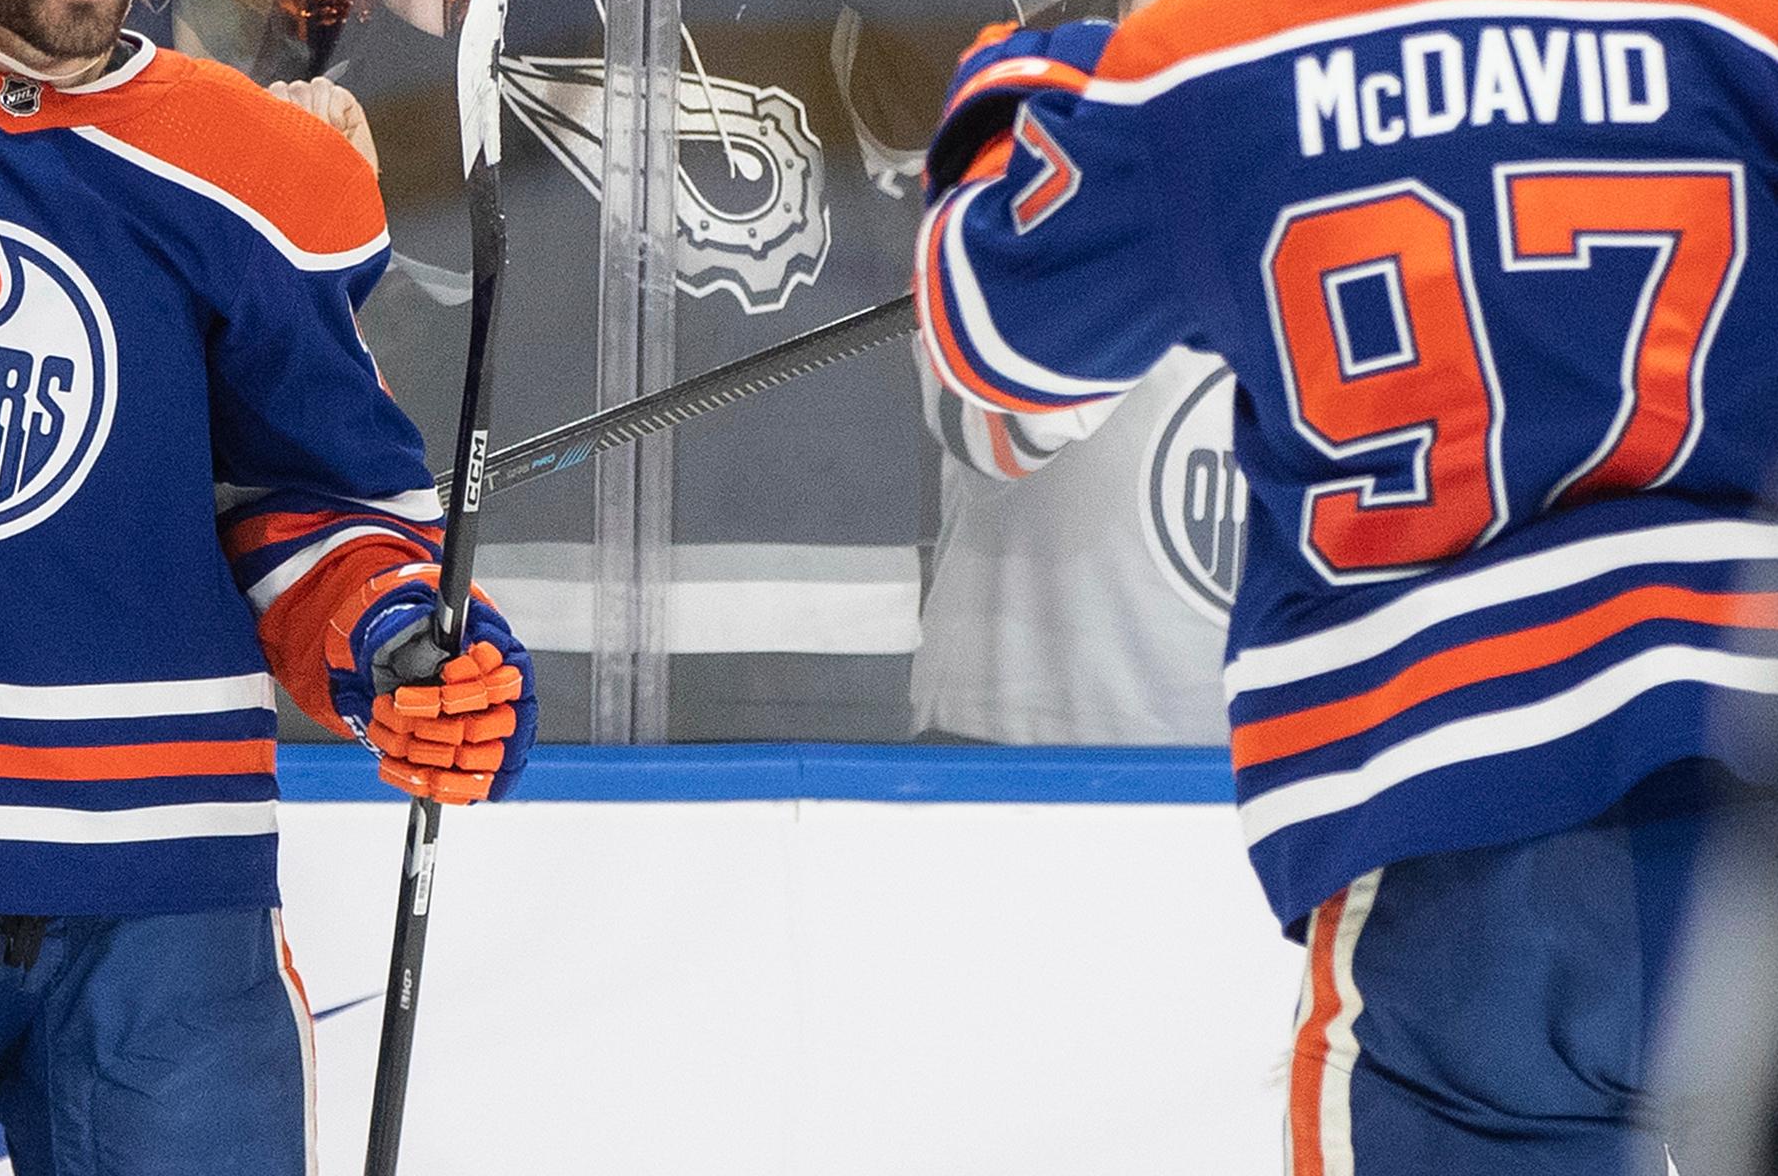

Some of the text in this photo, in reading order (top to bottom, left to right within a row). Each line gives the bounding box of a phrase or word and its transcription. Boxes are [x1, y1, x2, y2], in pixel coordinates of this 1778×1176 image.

[1294, 26, 1670, 157] McDAVID
[1261, 158, 1748, 587] 97
[466, 436, 486, 506] CCM
